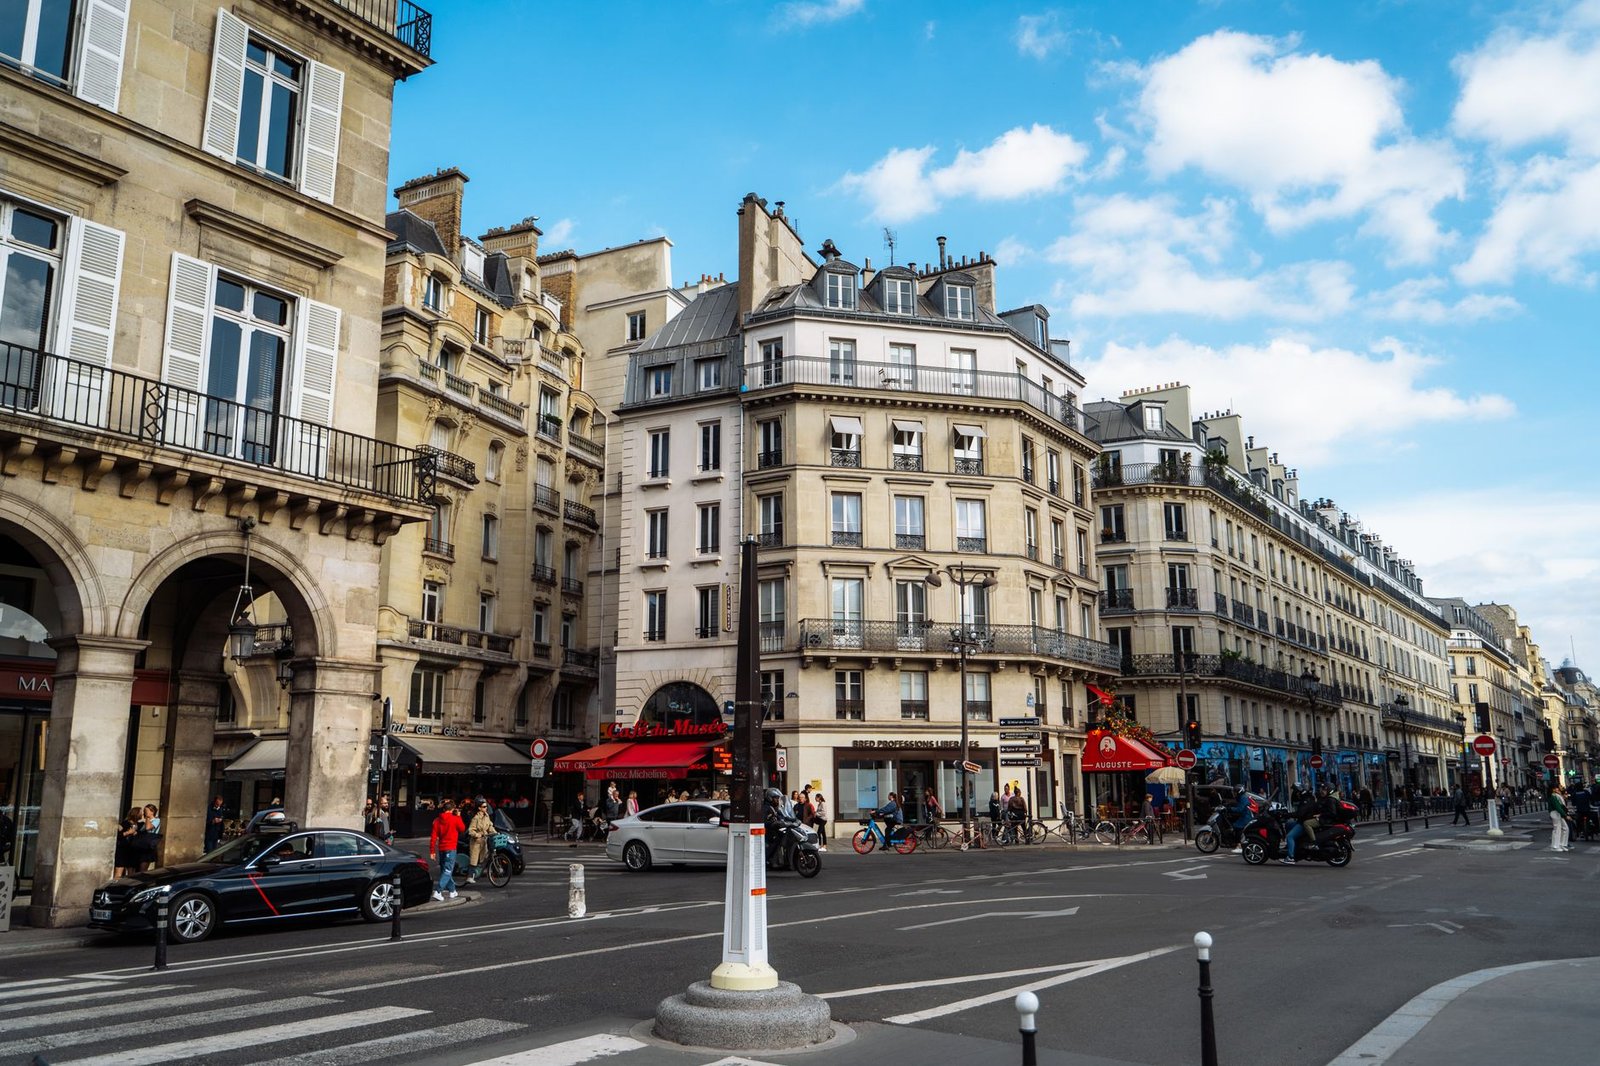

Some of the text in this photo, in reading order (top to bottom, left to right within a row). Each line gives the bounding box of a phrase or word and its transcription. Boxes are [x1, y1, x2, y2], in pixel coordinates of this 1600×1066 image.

[19, 676, 50, 692] MA
[416, 725, 434, 735] GRILL
[607, 718, 728, 738] Café du Musée
[853, 740, 979, 748] BRED PROFESSIONS LIBERES
[554, 761, 569, 769] RANT
[1095, 761, 1132, 769] AUGUSTE
[606, 769, 667, 779] Chez Micheline
